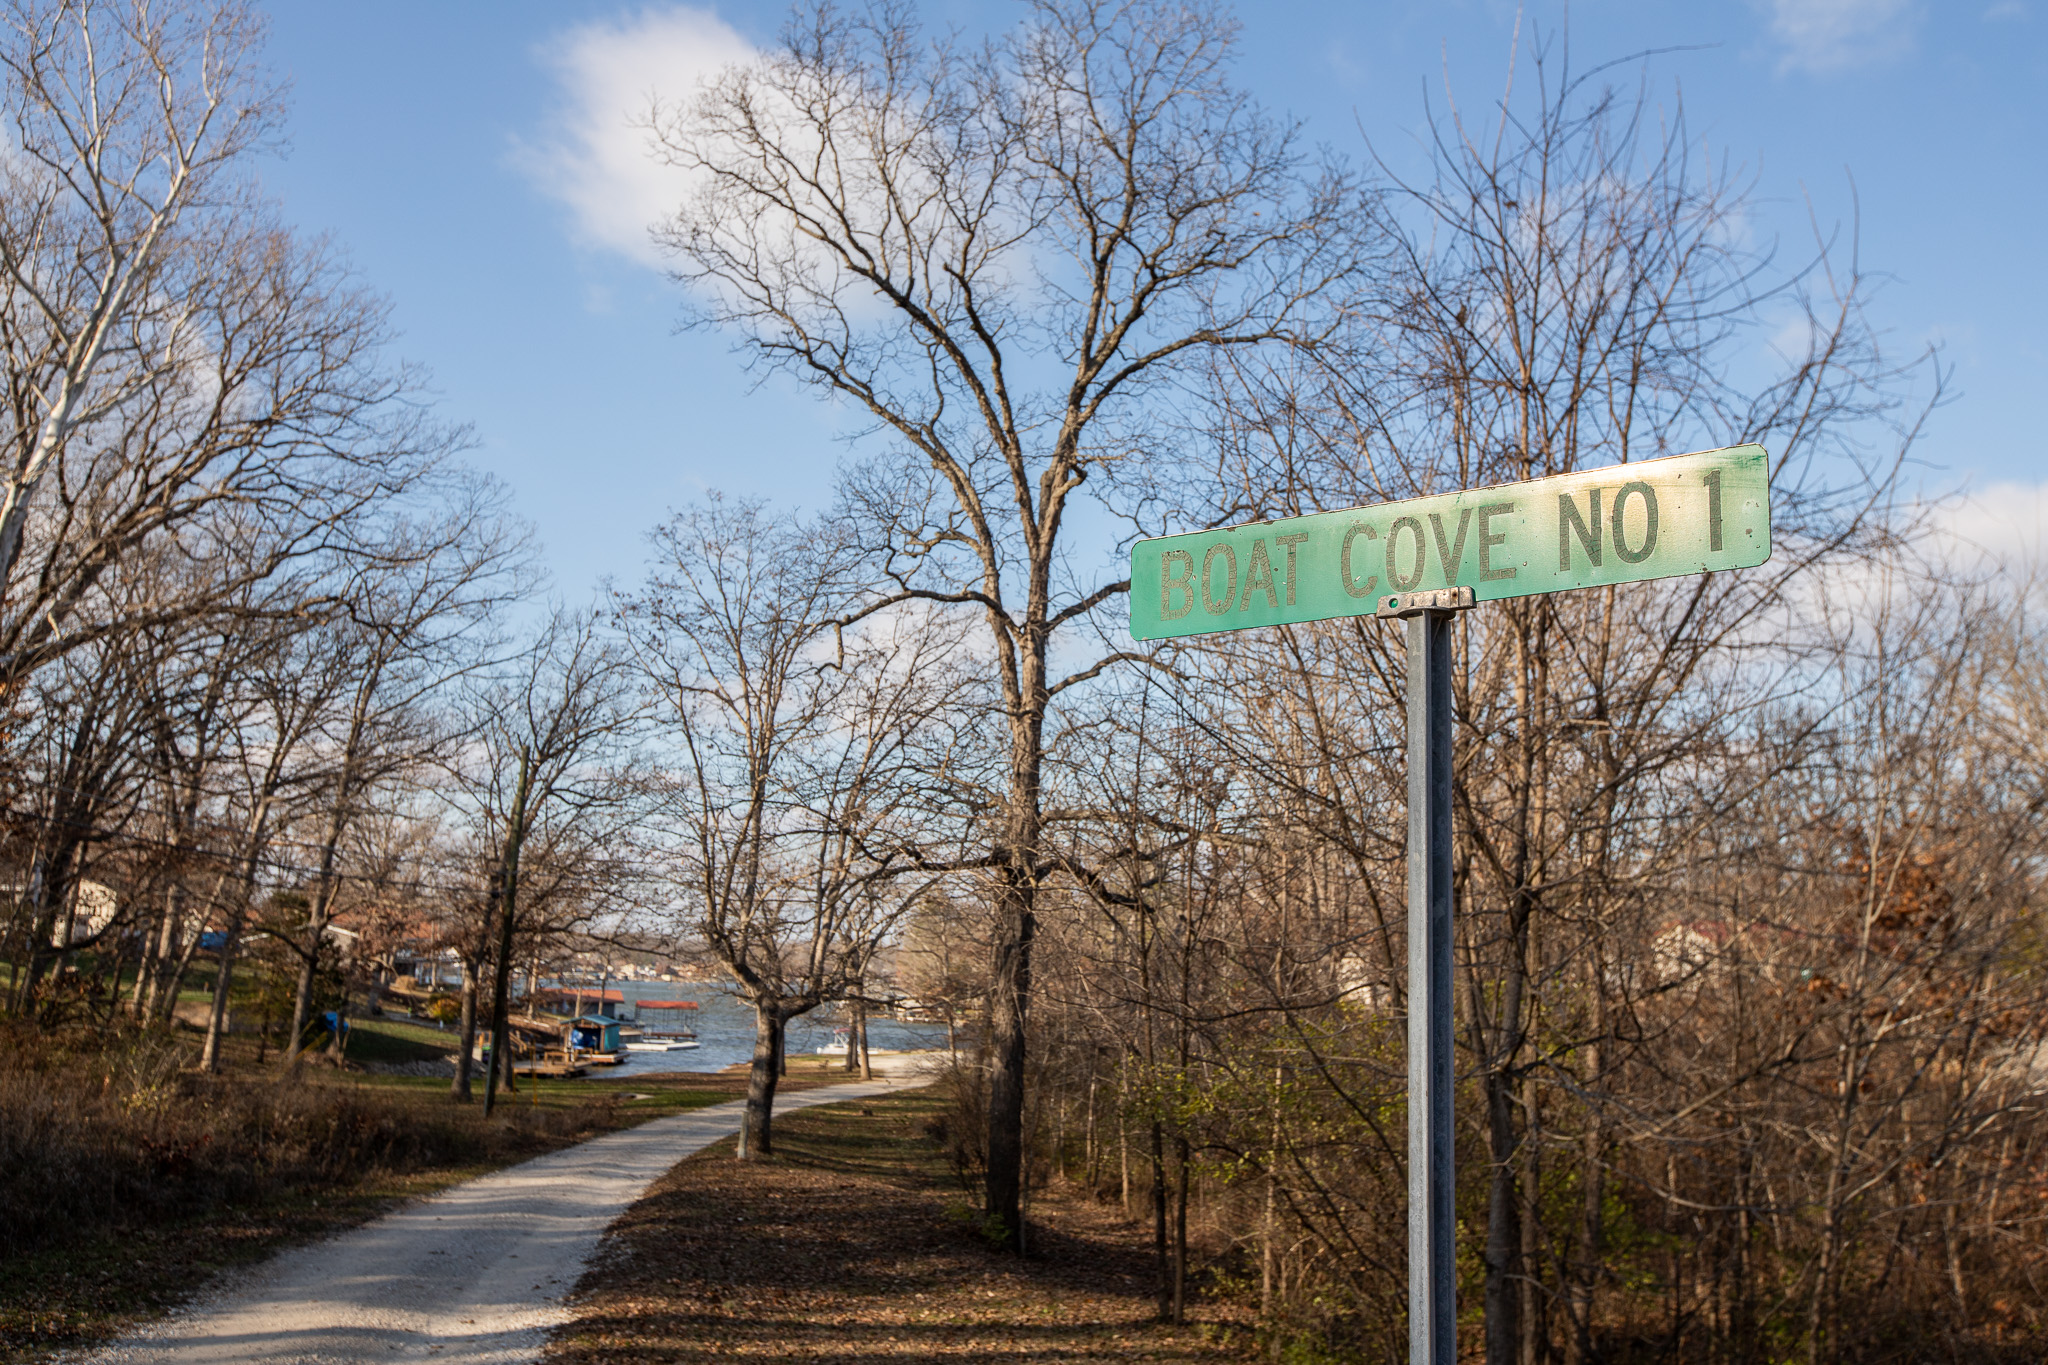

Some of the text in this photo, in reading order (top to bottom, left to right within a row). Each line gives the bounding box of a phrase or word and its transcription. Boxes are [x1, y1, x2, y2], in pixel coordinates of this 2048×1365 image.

[1160, 469, 1723, 621] BOAT COVE NO 1
